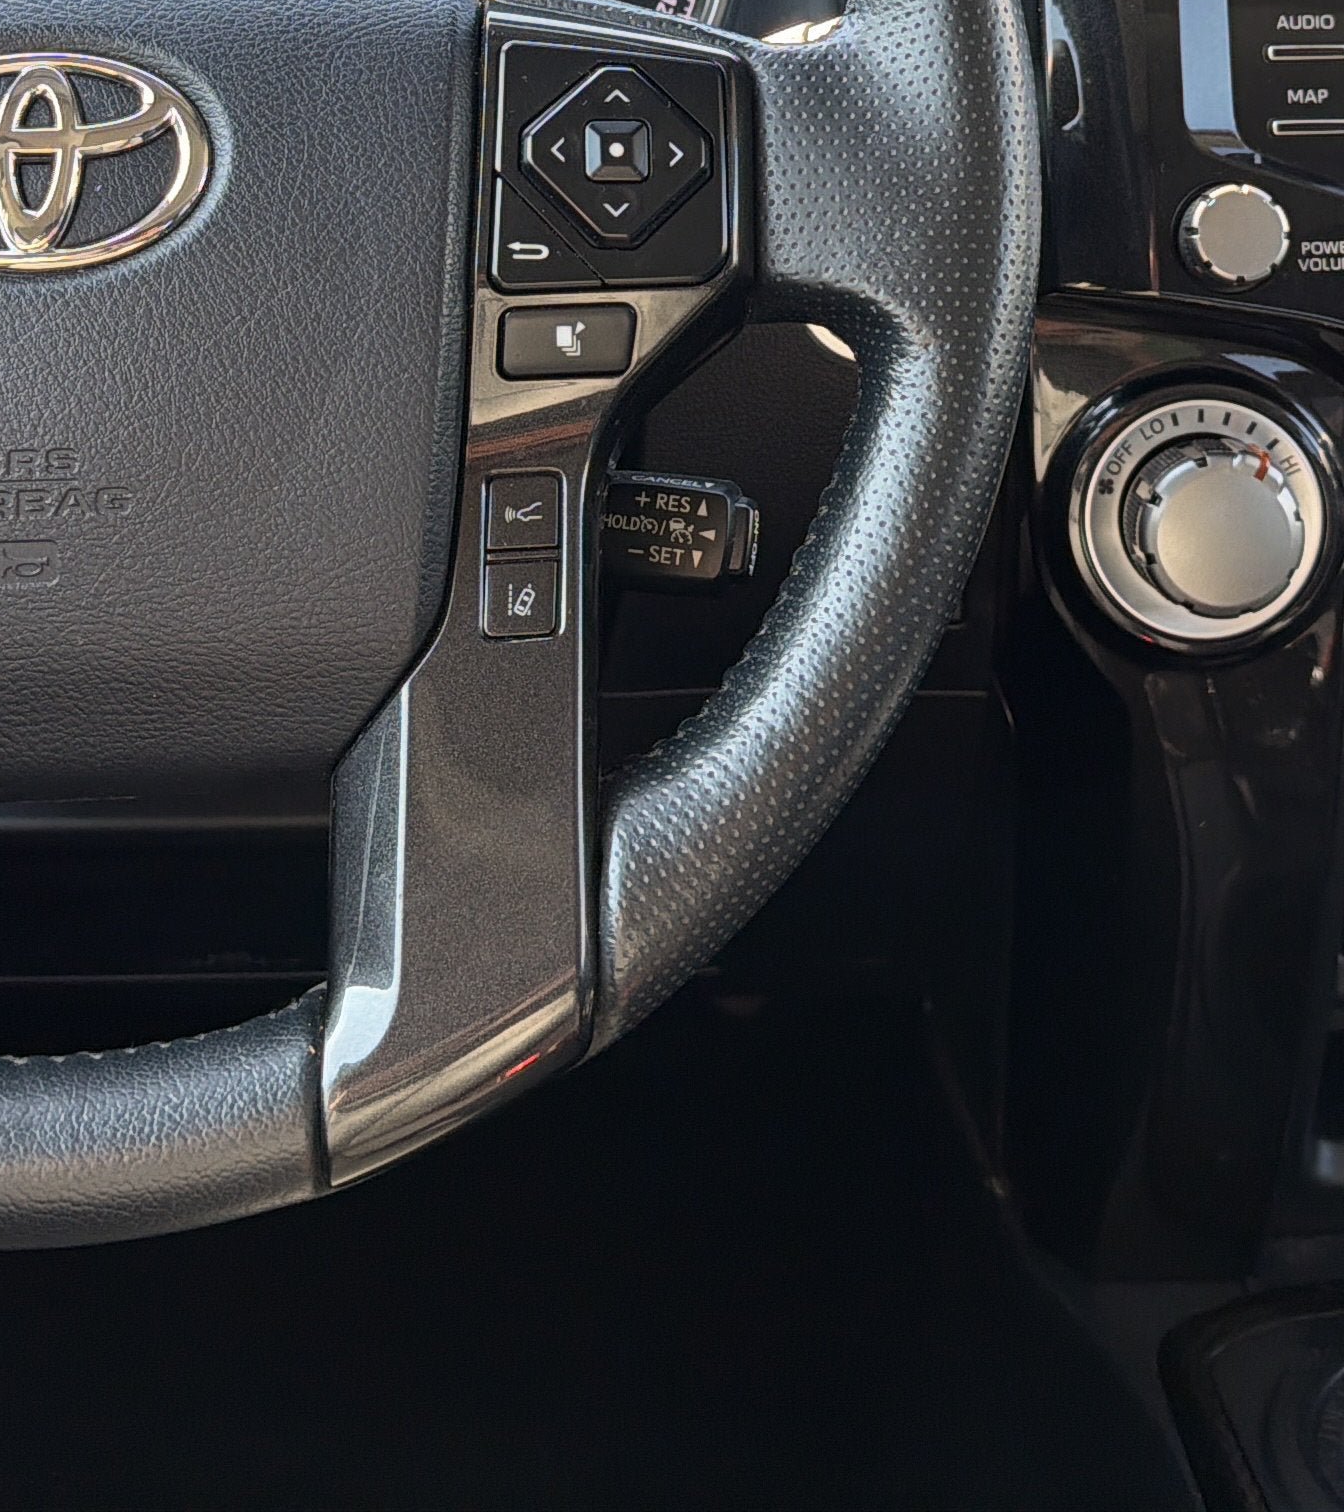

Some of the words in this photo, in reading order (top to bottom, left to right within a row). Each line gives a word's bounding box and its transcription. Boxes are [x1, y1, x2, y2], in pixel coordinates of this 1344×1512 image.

[1277, 14, 1335, 30] AUDIO
[1287, 89, 1328, 104] MAP
[1139, 418, 1165, 441] LO
[1106, 440, 1133, 477] OFF
[1279, 454, 1302, 475] HI
[631, 475, 702, 488] CANCEL
[656, 493, 691, 513] RES
[649, 545, 685, 566] SET
